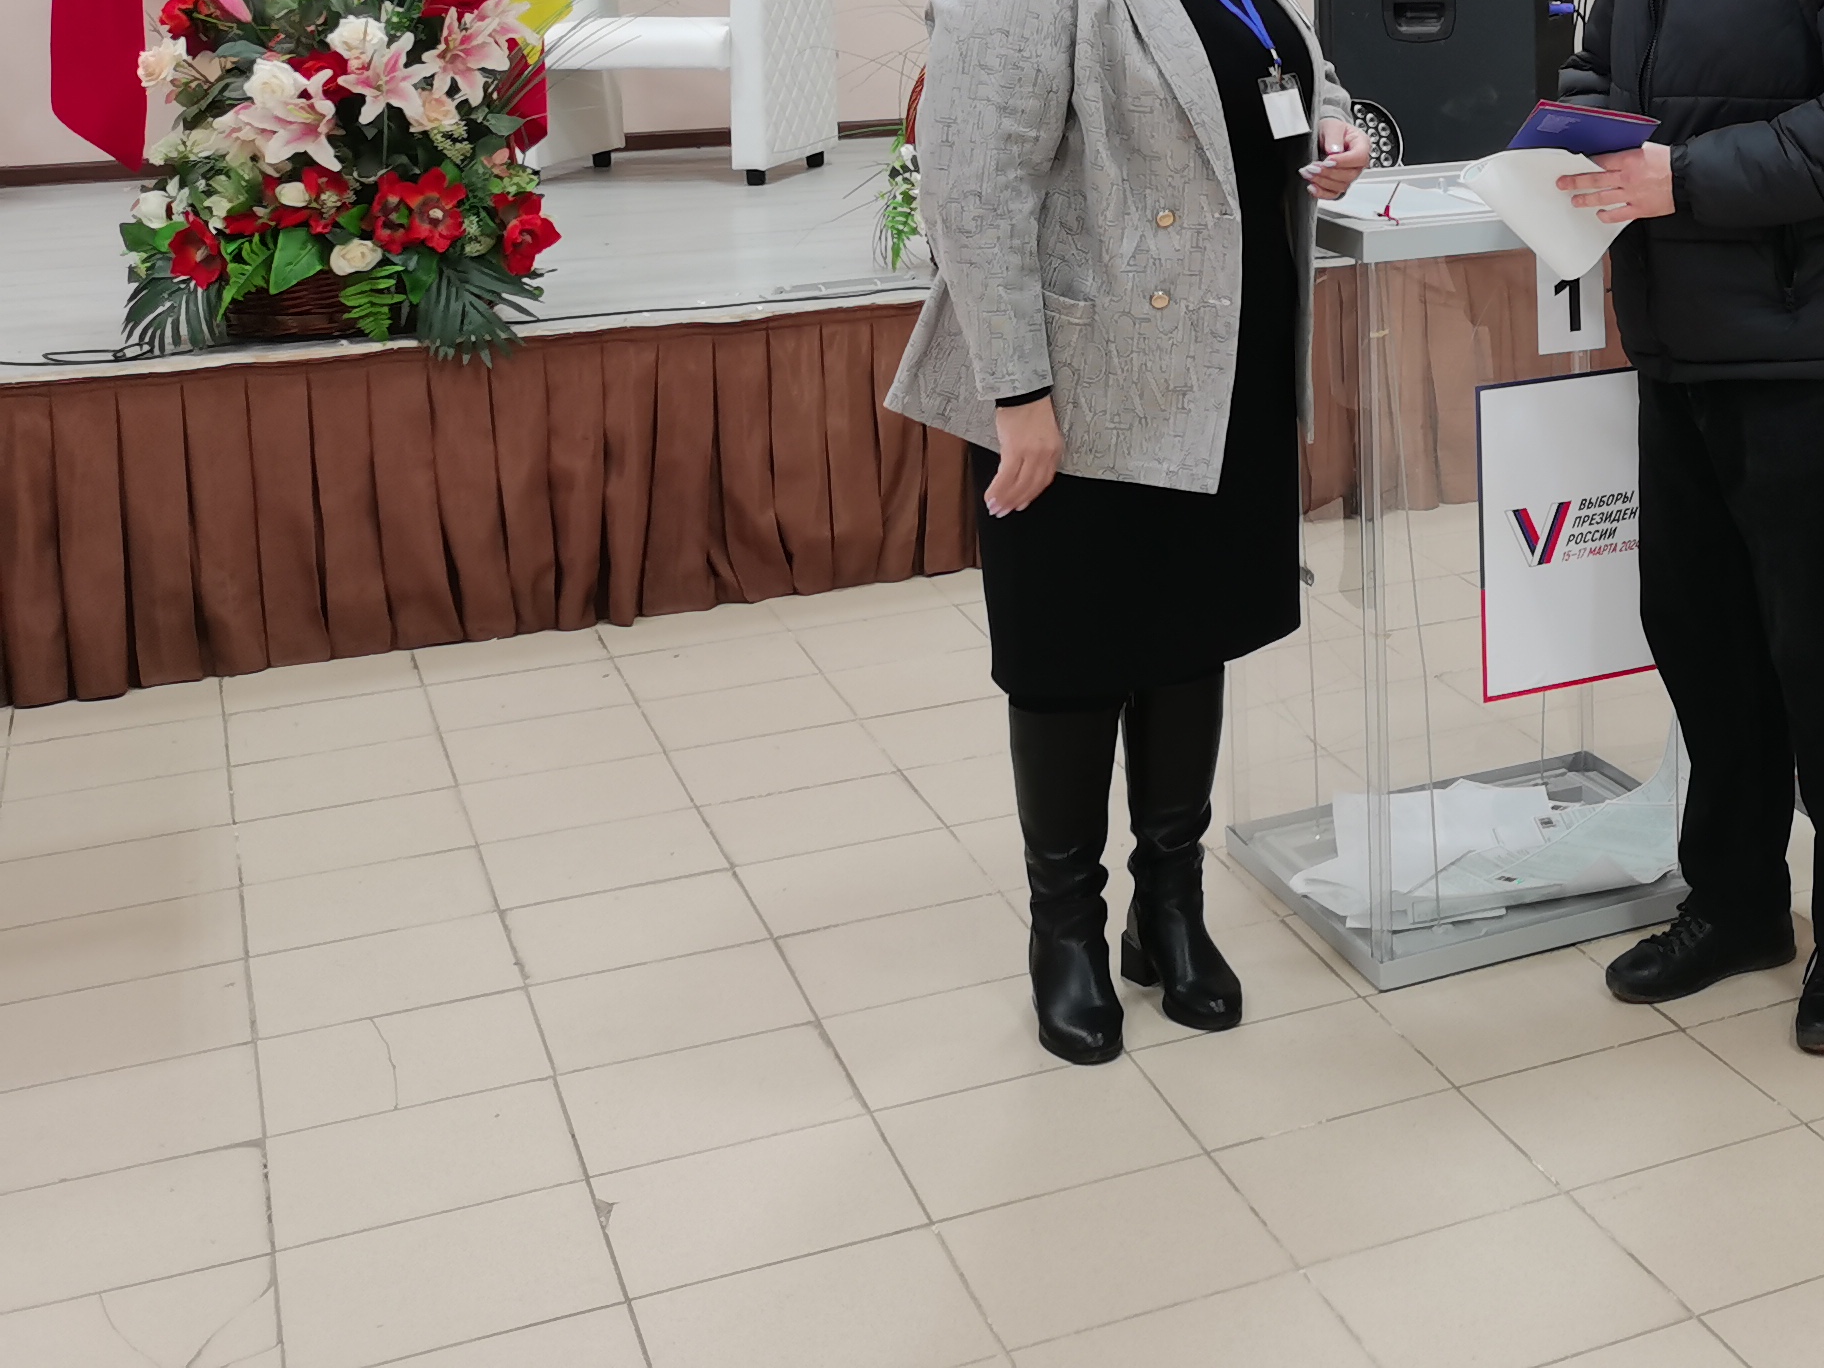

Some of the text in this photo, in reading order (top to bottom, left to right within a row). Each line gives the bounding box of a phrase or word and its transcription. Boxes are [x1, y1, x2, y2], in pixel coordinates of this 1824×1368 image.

[1554, 277, 1582, 333] 1
[1578, 490, 1635, 512] ВЫБОРЫ
[1571, 506, 1640, 530] ПРЕЗИДЕН
[1566, 526, 1618, 547] РОССИИ
[1587, 542, 1618, 559] МАРТА
